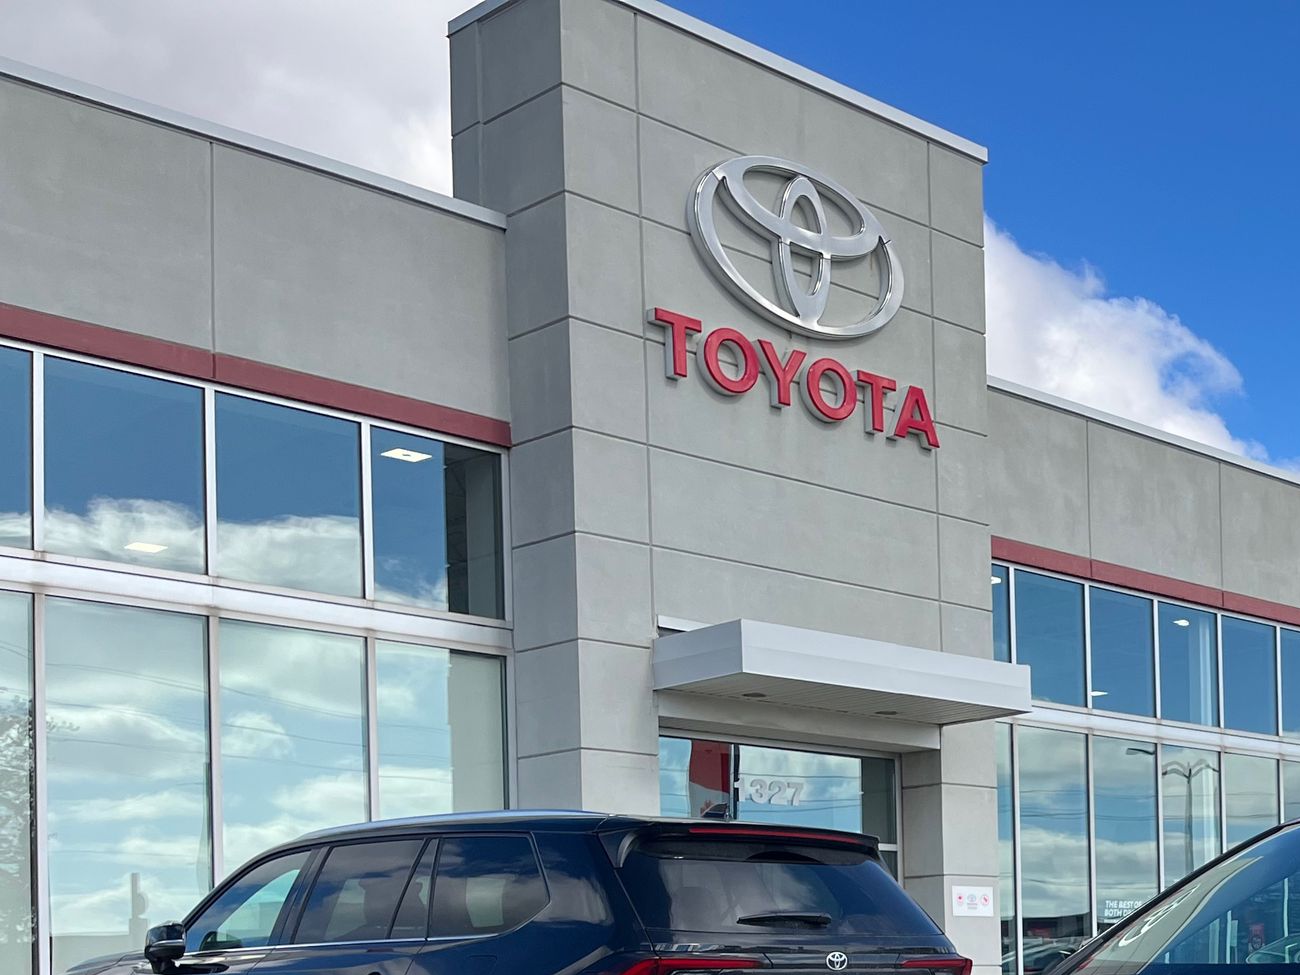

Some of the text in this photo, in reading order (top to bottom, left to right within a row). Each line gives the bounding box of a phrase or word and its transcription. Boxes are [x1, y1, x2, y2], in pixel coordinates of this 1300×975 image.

[648, 307, 940, 451] TOYOTA
[734, 777, 805, 807] 1327
[1104, 909, 1122, 917] BOTH
[1105, 900, 1118, 908] THE
[1119, 900, 1134, 909] BEST
